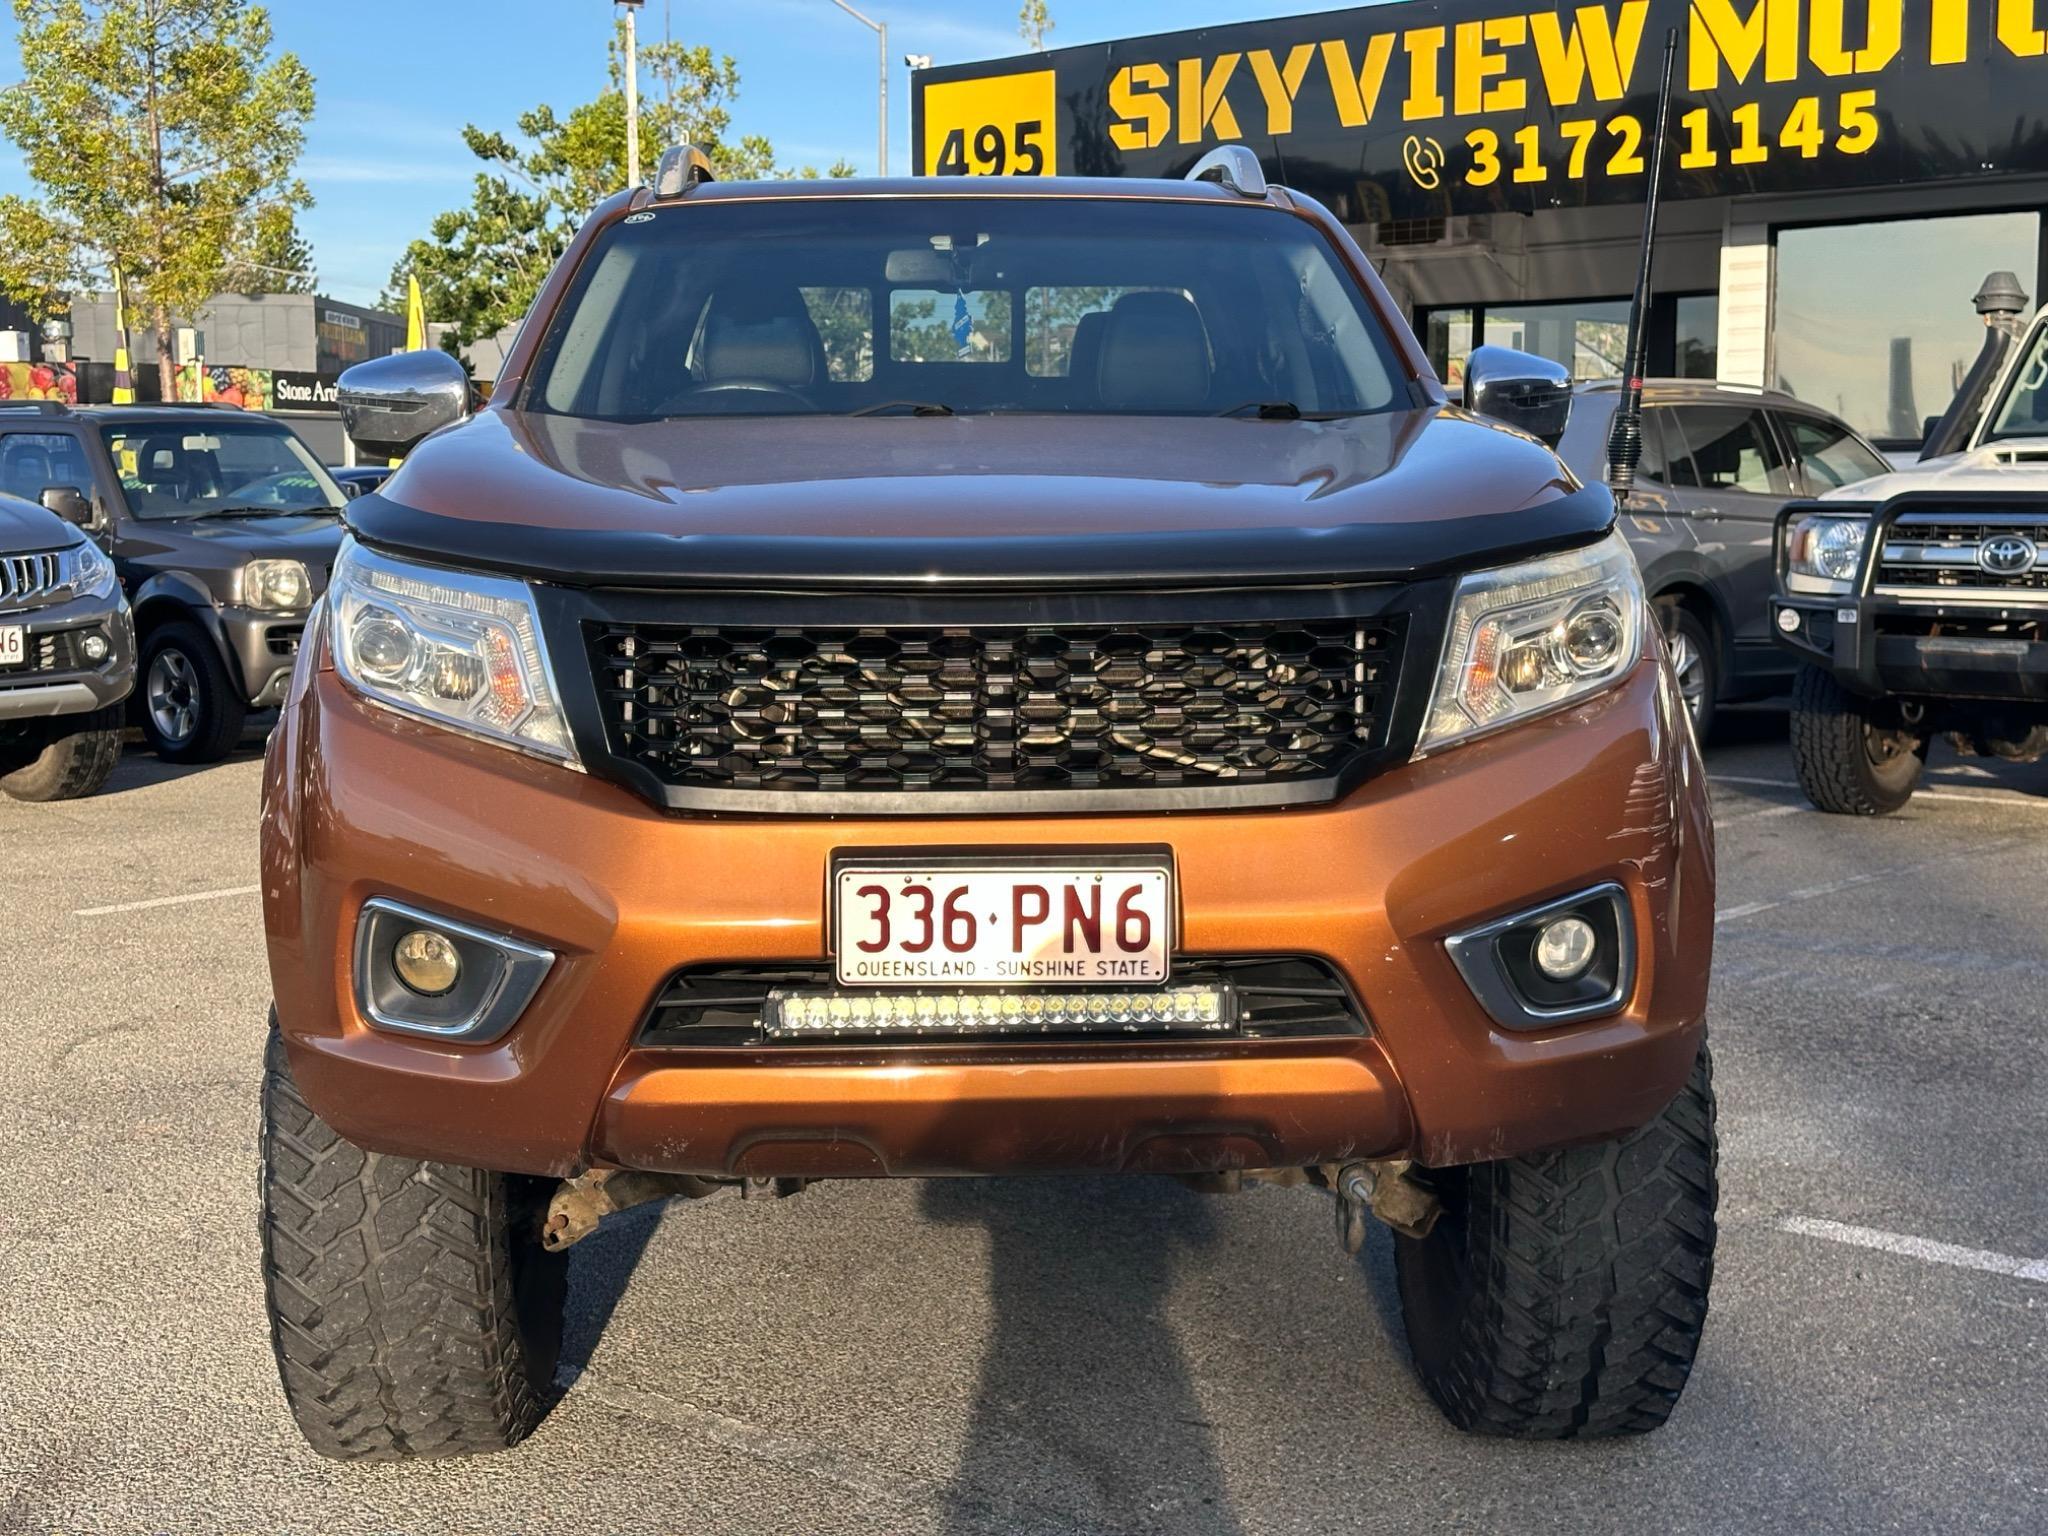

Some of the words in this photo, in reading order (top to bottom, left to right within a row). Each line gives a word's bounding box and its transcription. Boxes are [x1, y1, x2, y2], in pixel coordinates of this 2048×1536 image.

[1108, 0, 1650, 150] SKYVIEW
[936, 120, 1044, 176] 495
[1464, 114, 1645, 187] 3172
[1680, 89, 1879, 169] 1145
[277, 379, 312, 401] Stone
[856, 885, 977, 953] 336
[1012, 884, 1151, 953] PN6
[857, 960, 976, 977] QUEENSLAND
[996, 960, 1086, 977] SUNSHINE
[1096, 960, 1150, 977] STATE
